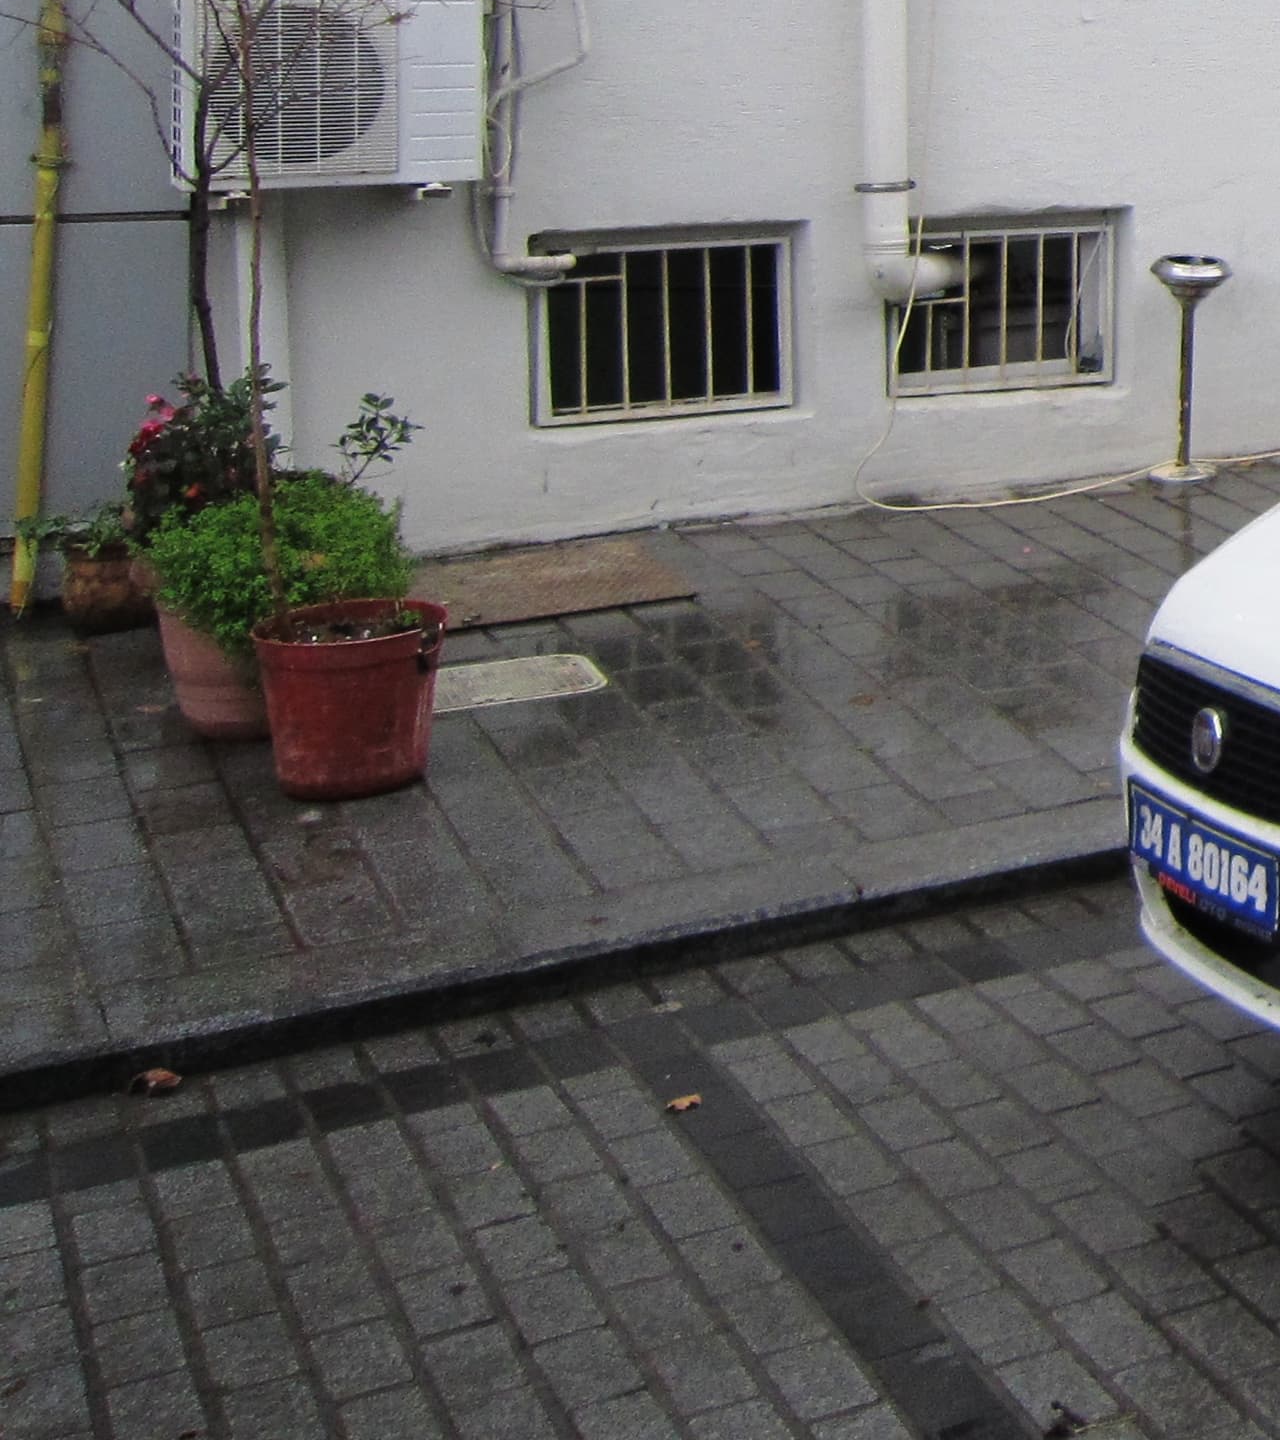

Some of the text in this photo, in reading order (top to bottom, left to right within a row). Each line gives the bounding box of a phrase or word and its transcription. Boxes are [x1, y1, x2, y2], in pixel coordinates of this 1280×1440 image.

[1140, 805, 1267, 912] 34 A 80164
